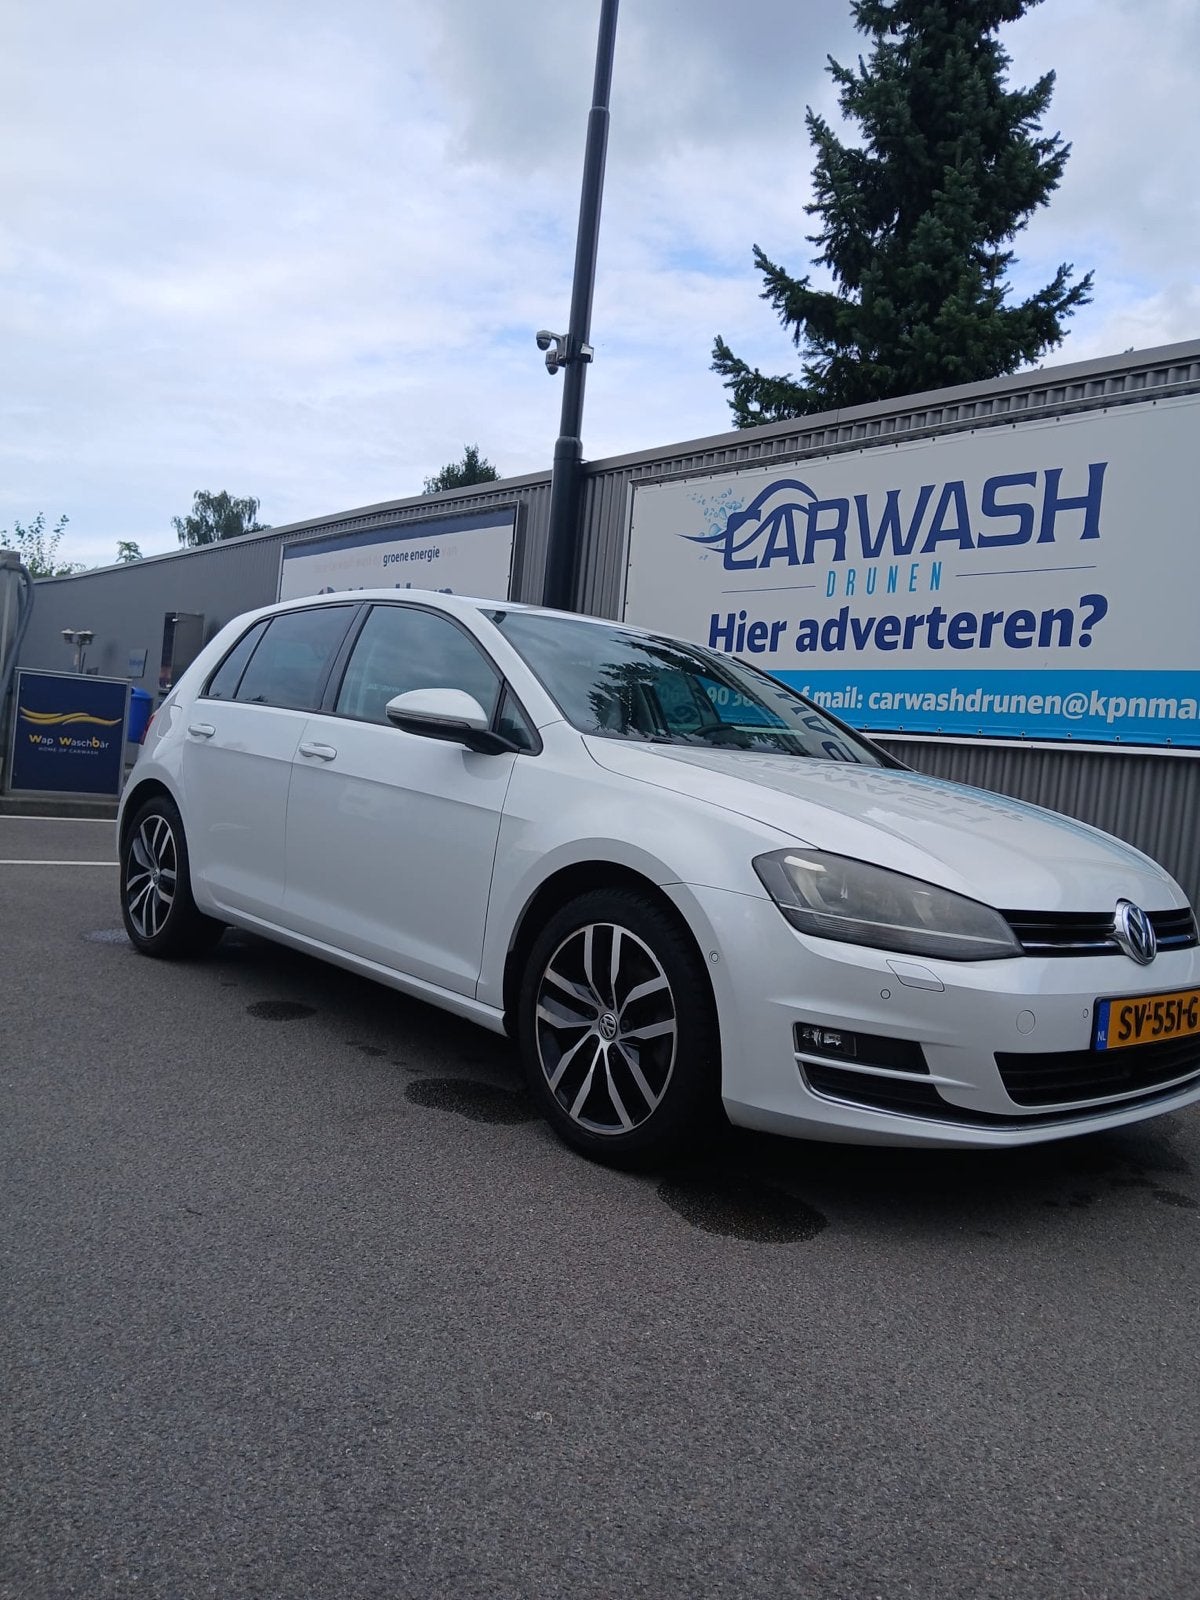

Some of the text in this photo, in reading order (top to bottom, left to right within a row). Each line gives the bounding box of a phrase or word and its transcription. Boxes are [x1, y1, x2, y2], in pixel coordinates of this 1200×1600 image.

[721, 462, 1108, 570] CARWASH
[383, 549, 409, 567] groene
[409, 545, 440, 563] energie
[826, 561, 943, 598] DRUNEN
[708, 594, 1109, 653] Hier adverteren?
[813, 685, 864, 709] mail:
[868, 687, 1200, 724] carwashdrunen@kpnma
[28, 734, 54, 746] Wap
[1097, 1030, 1107, 1042] NL
[1118, 996, 1198, 1041] SV-551-G
